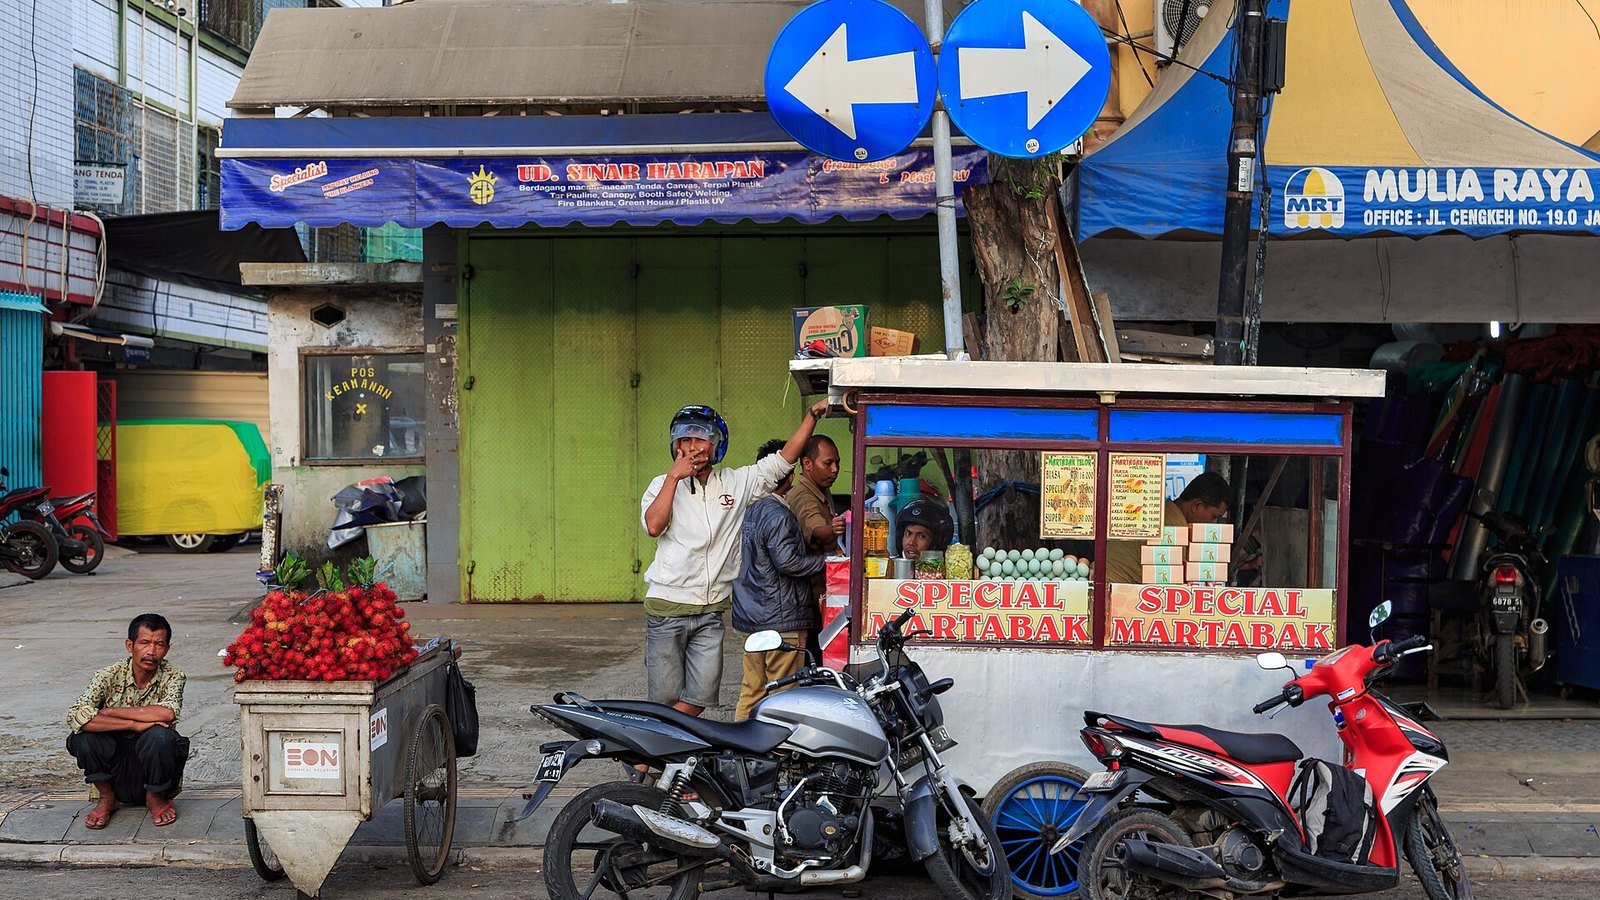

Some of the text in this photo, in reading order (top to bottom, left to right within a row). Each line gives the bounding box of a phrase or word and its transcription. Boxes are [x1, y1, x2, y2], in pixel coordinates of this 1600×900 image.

[96, 170, 123, 179] TENDA
[269, 161, 328, 192] Specialist
[517, 161, 764, 182] UD. SINAR HARAPAN
[901, 170, 936, 184] Plast
[519, 184, 566, 192] Berdagang
[568, 183, 633, 191] macam-macam
[666, 190, 694, 198] Safety
[1363, 169, 1594, 202] MULIA RAYA
[1286, 197, 1343, 213] MRT
[1363, 209, 1413, 226] OFFICE
[1425, 209, 1446, 226] JL.
[1450, 209, 1514, 226] CENGKEH
[1518, 209, 1542, 226] NO.
[351, 367, 376, 378] POS
[325, 379, 393, 401] KEAMANAN
[893, 581, 1066, 611] SPECIAL
[1136, 586, 1307, 618] SPECIAL
[869, 612, 1090, 642] MARTABAK
[1111, 617, 1332, 649] MARTABAK
[372, 714, 387, 738] EON
[287, 749, 338, 767] EON
